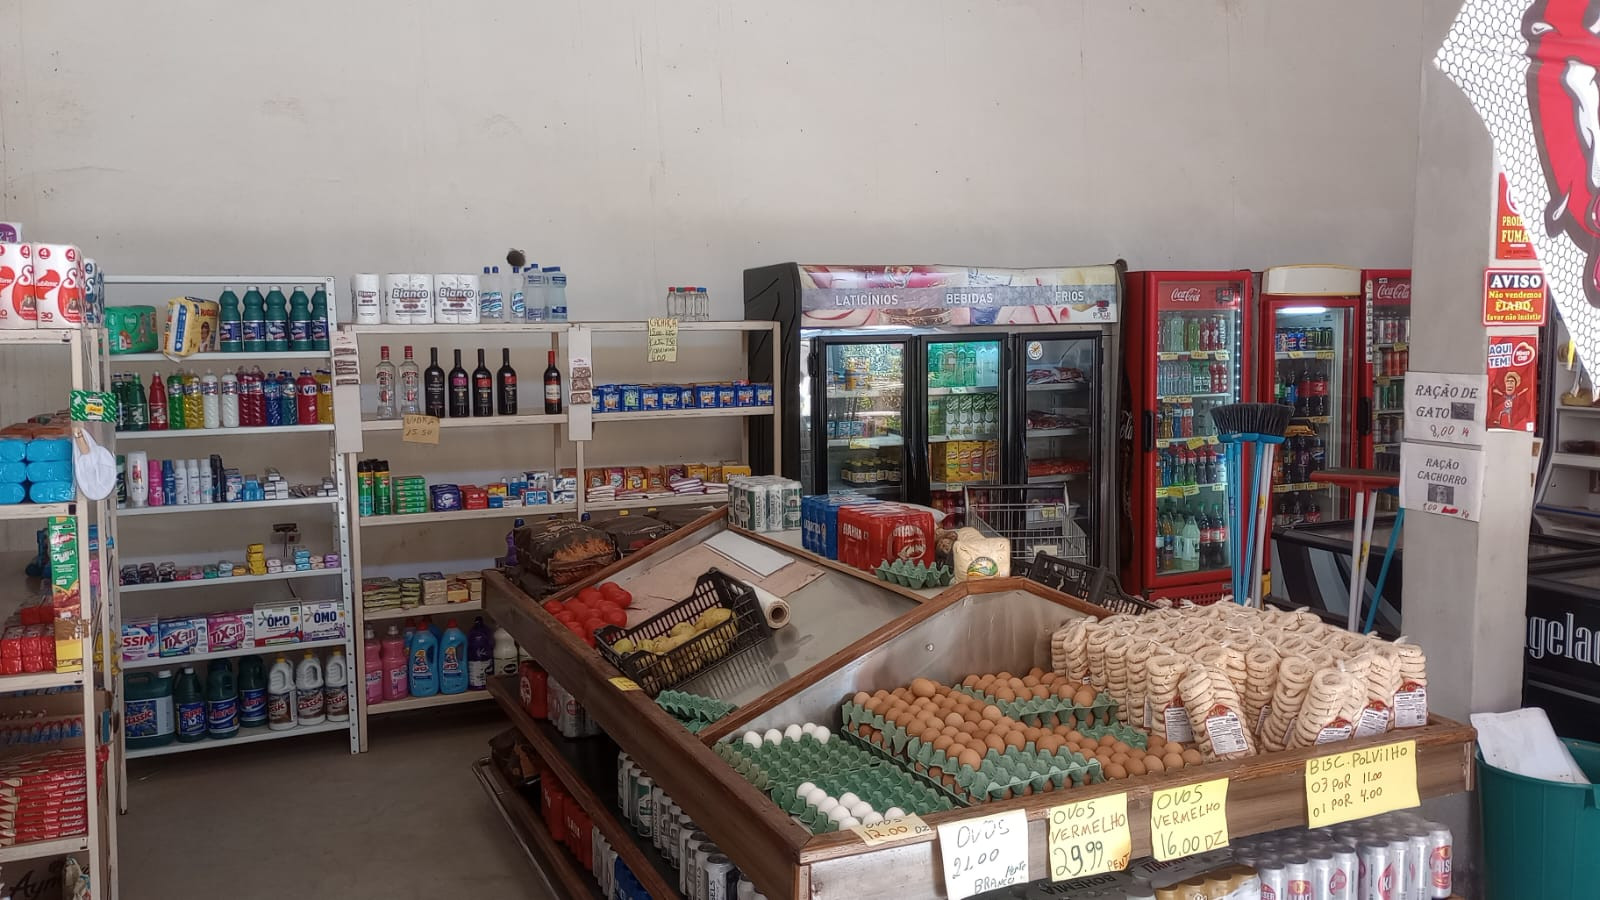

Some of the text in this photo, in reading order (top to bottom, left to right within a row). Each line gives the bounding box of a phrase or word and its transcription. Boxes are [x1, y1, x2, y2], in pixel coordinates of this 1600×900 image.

[1501, 229, 1530, 243] FUMA
[1490, 275, 1541, 289] AVISO
[392, 288, 428, 299] Bianco
[439, 287, 475, 299] Bianco
[835, 293, 898, 306] LATICÍNIOS
[946, 292, 993, 305] BEBIDAS
[1055, 290, 1084, 302] FRIOS
[1505, 291, 1541, 299] vendemos
[1489, 344, 1511, 354] AQUI
[1489, 356, 1510, 367] TEM!
[1415, 383, 1479, 399] RAÇÃO DE
[1416, 406, 1450, 419] GATO
[1425, 457, 1460, 470] RAÇÃO
[1417, 470, 1467, 486] CACHORRO
[1311, 777, 1328, 793] 03
[1157, 785, 1203, 810] OVOS
[1313, 803, 1326, 817] 01
[1360, 786, 1383, 803] 4.00
[1054, 801, 1096, 825] OVOS
[1153, 801, 1221, 830] VERMELHO
[1051, 812, 1126, 844] VERMELHO
[1205, 830, 1227, 851] DZ
